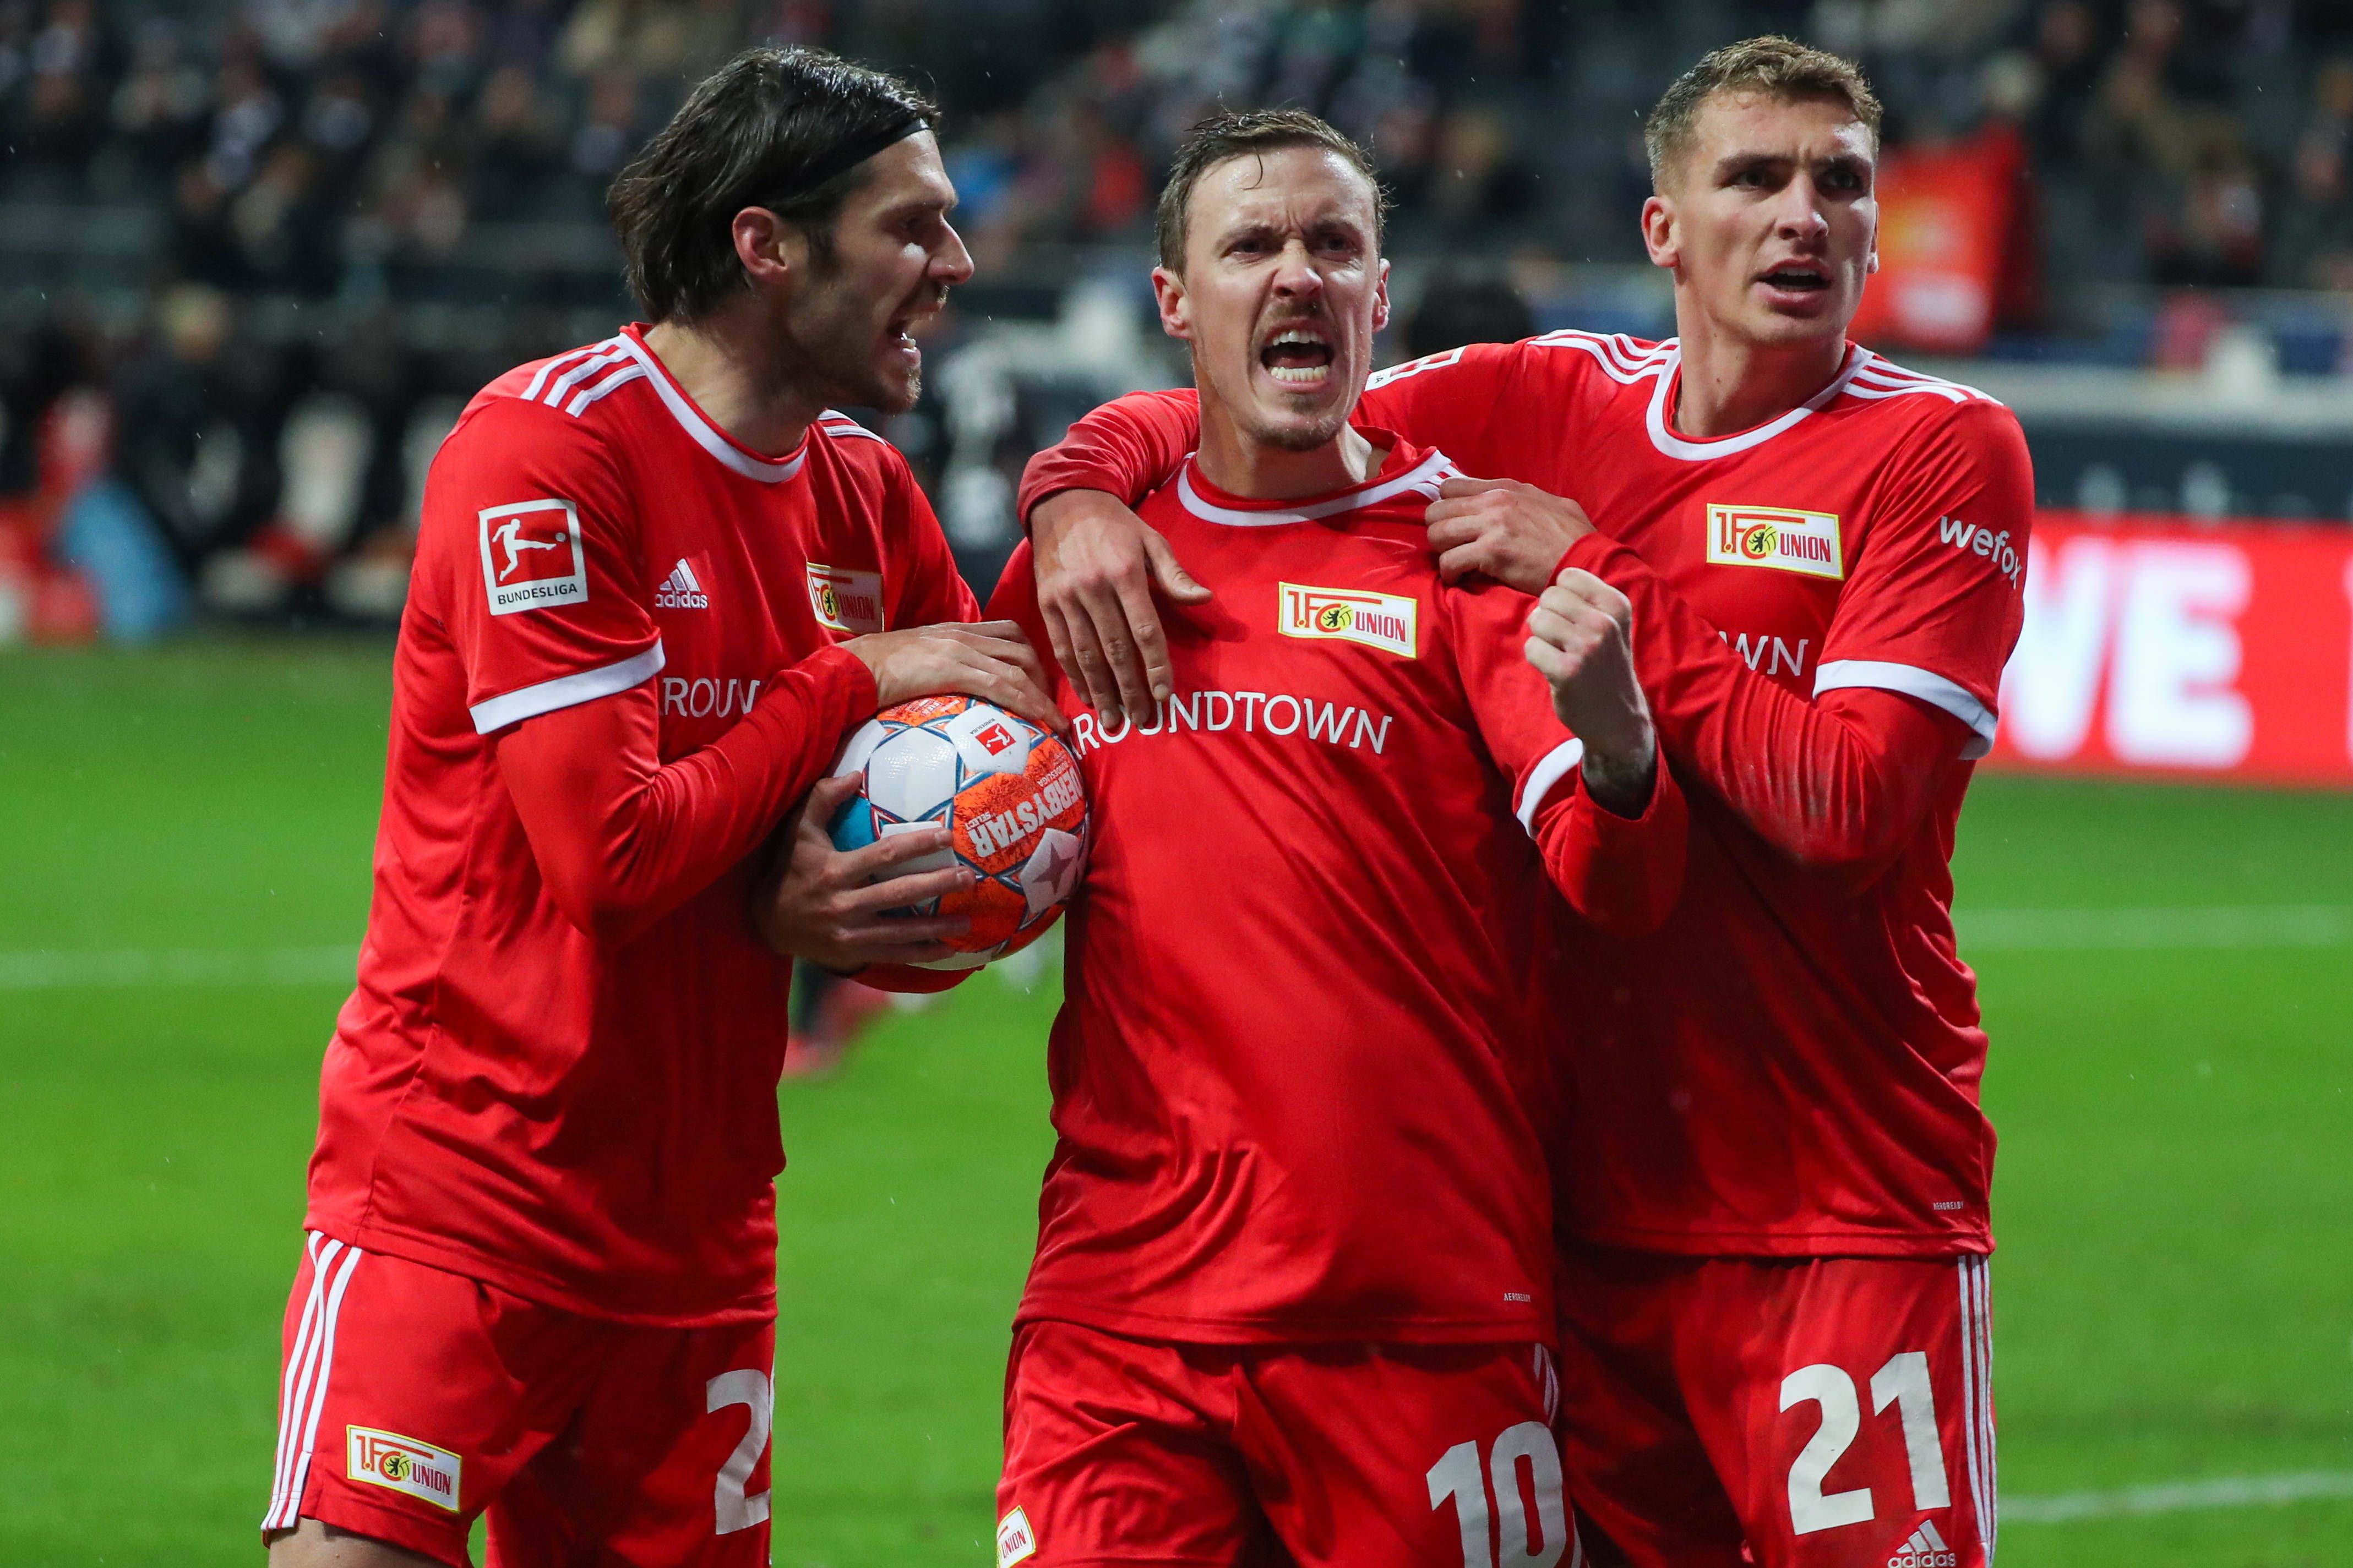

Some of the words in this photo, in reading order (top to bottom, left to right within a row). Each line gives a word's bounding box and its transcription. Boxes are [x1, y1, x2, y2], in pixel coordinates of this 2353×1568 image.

[1780, 532, 1831, 562] UNION
[1940, 516, 2022, 590] wefox
[498, 583, 578, 605] BUNDESLIGA
[655, 591, 708, 609] adidas
[838, 594, 875, 620] UNION
[1355, 611, 1406, 642] UNION
[660, 678, 761, 718] ROUN
[1071, 691, 1392, 761] ROUNDTOWN
[968, 765, 1084, 858] DERBYSTAR
[706, 1369, 770, 1535] 2
[1779, 1351, 1951, 1536] 21
[412, 1462, 451, 1496] UNION
[1426, 1421, 1567, 1568] 10
[1001, 1528, 1027, 1559] UNION
[1888, 1551, 1956, 1568] adidas
